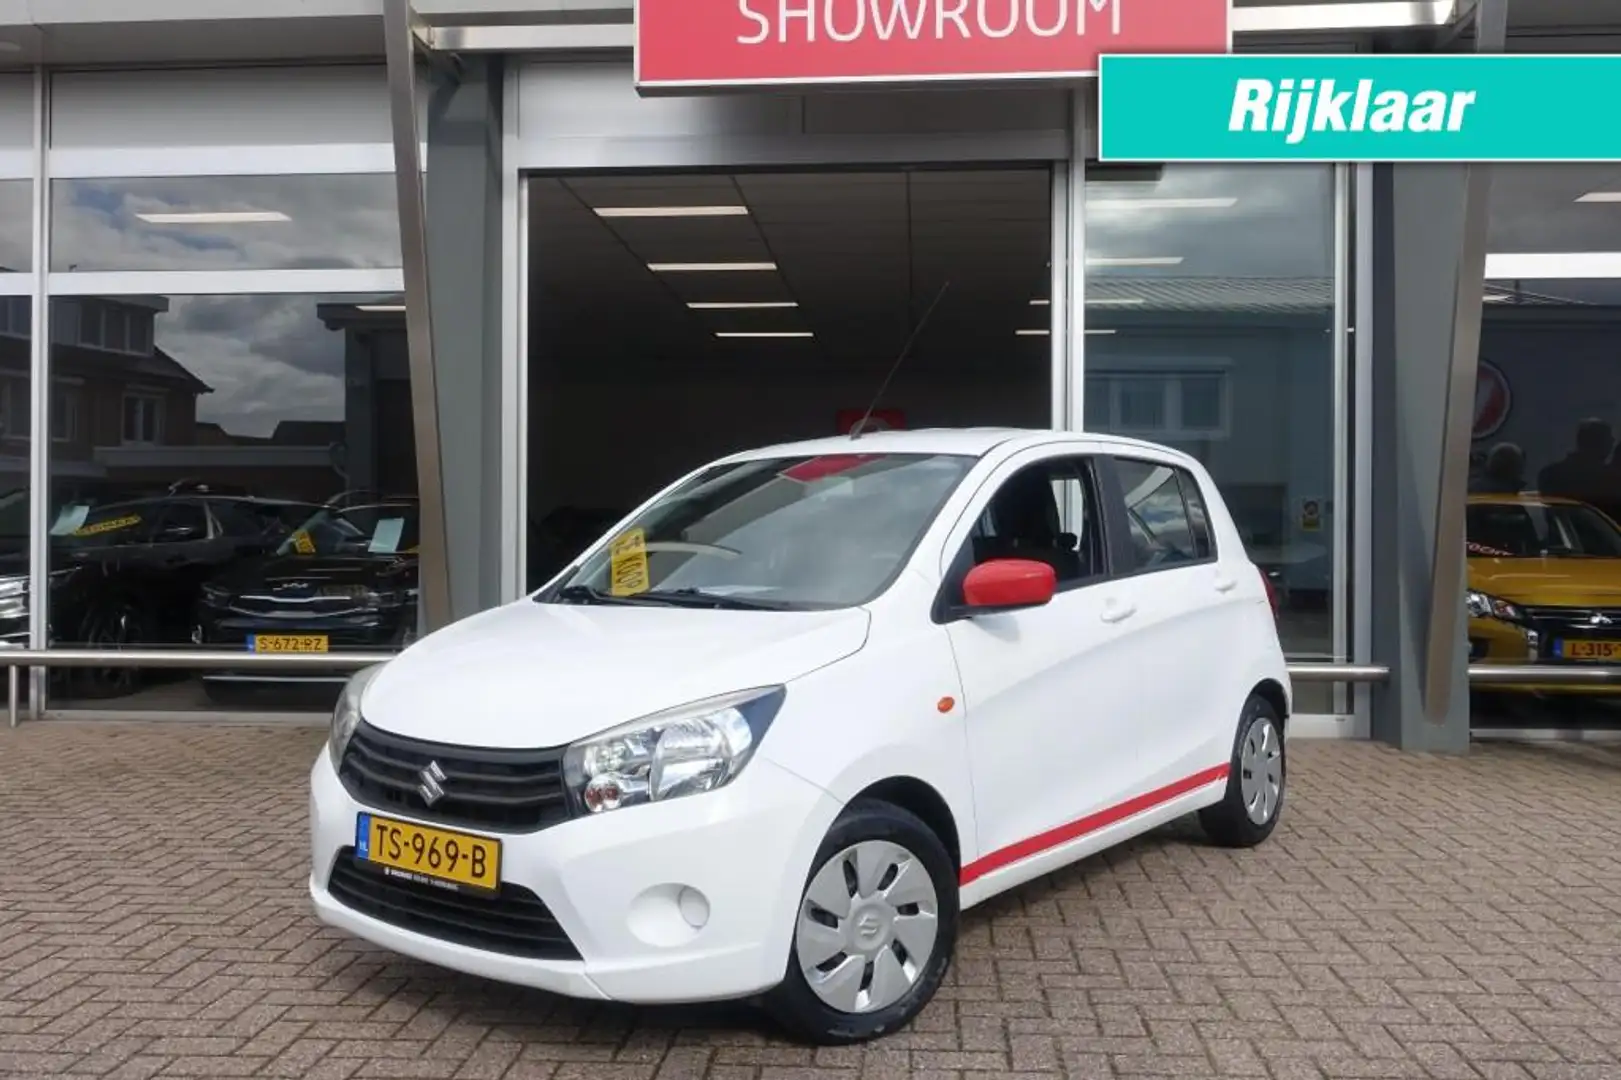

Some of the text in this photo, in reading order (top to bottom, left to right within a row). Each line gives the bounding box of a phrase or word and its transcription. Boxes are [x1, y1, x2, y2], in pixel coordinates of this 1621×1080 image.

[737, 0, 1120, 43] SHOWROOM
[259, 637, 323, 651] S-672-RZ
[376, 824, 486, 878] TS-969-B
